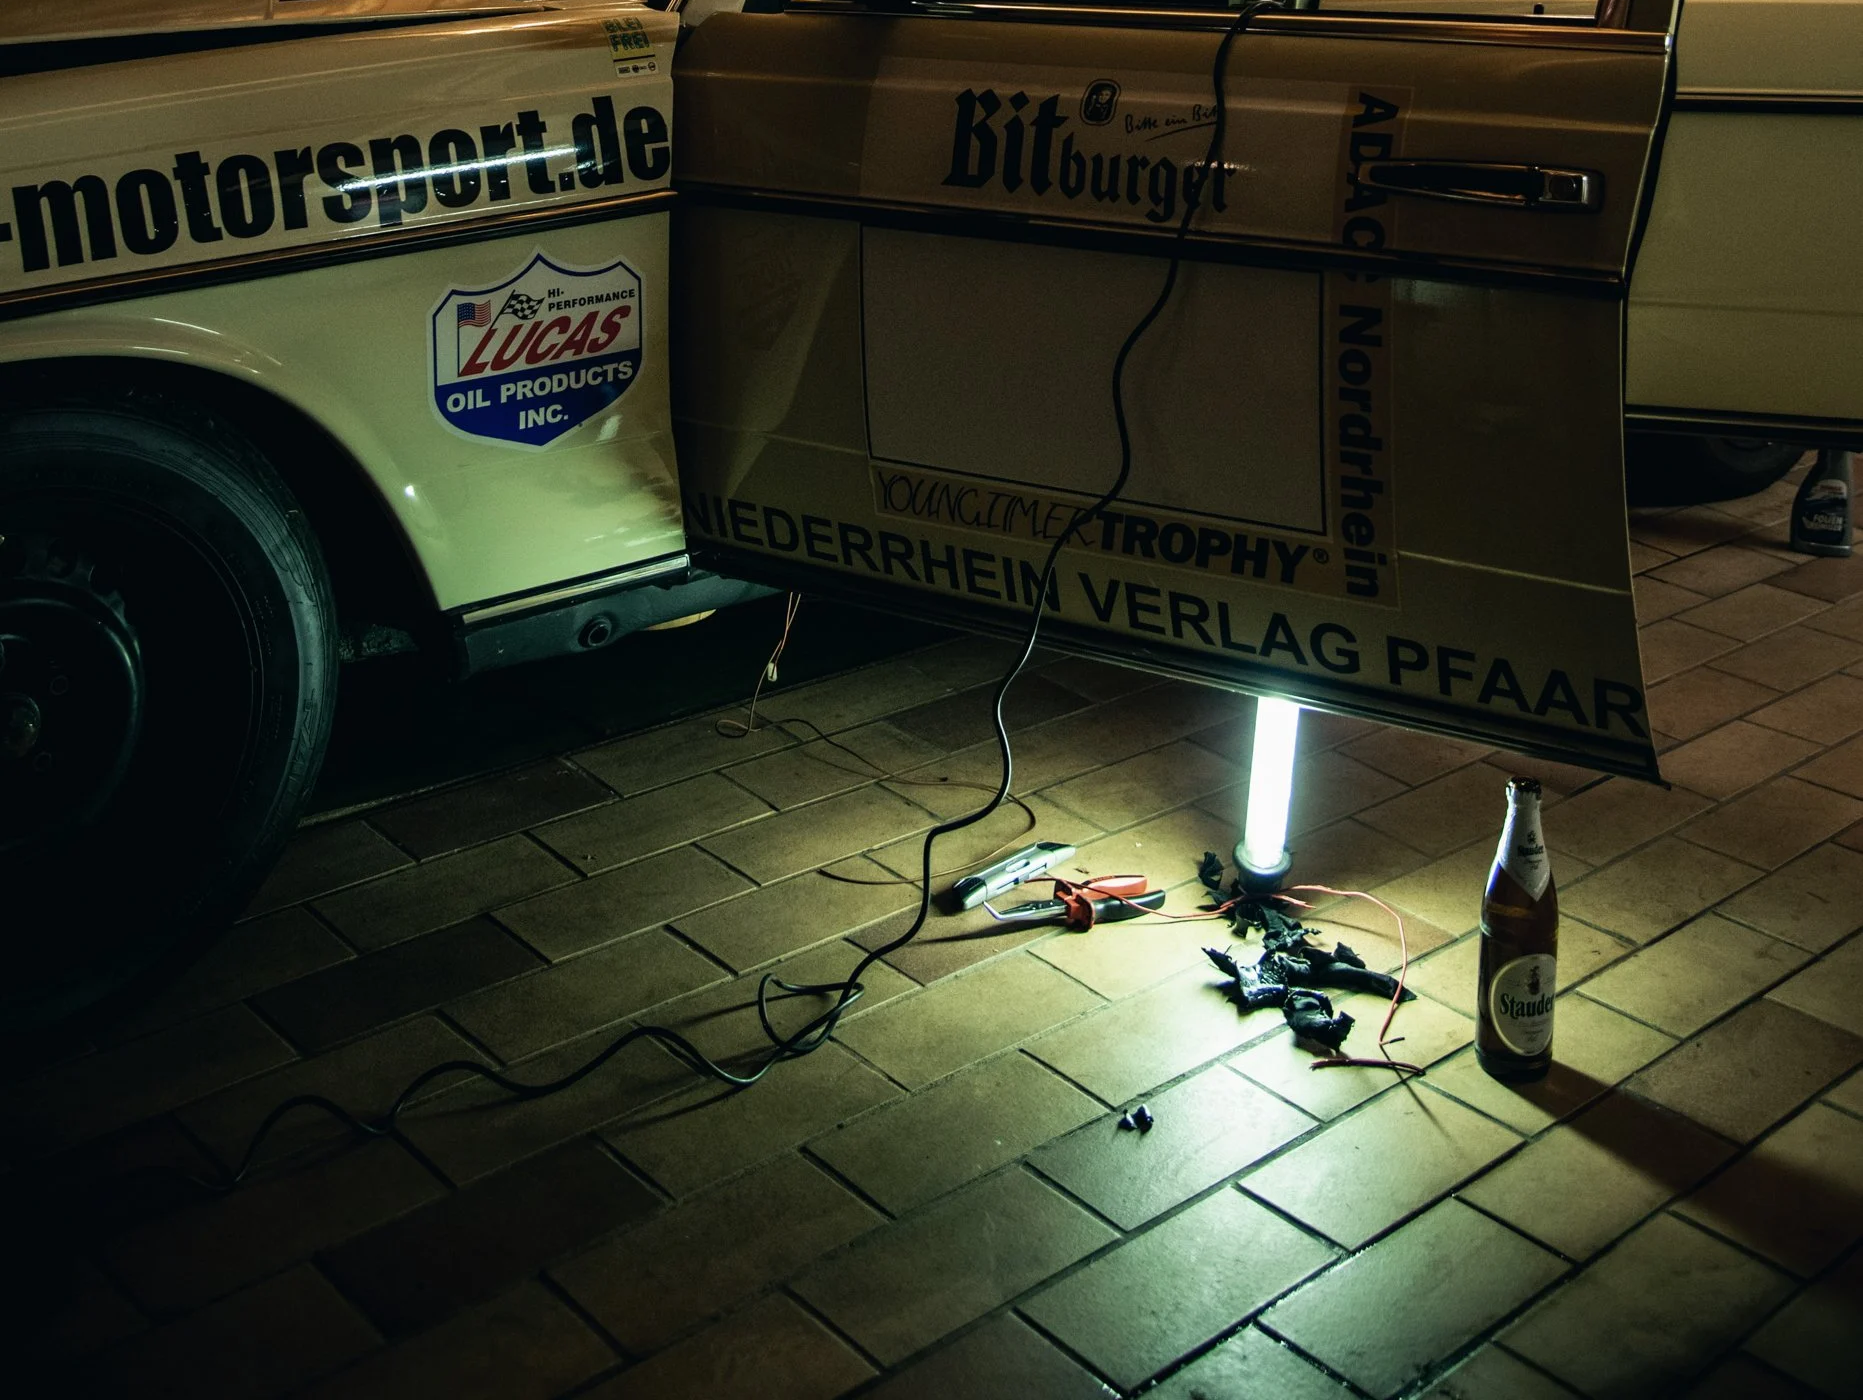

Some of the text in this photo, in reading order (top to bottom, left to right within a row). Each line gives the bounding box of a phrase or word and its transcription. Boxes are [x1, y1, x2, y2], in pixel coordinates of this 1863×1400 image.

[941, 88, 1236, 222] Bitburger
[548, 289, 636, 311] PERFORMANCE
[460, 305, 631, 377] LUCAS
[1338, 92, 1400, 597] ADAC Nordrhein
[446, 360, 633, 413] OIL PRODUCTS
[518, 404, 569, 430] INC.
[683, 490, 1649, 738] NIEDERRHEIN VERLAG PFAAR
